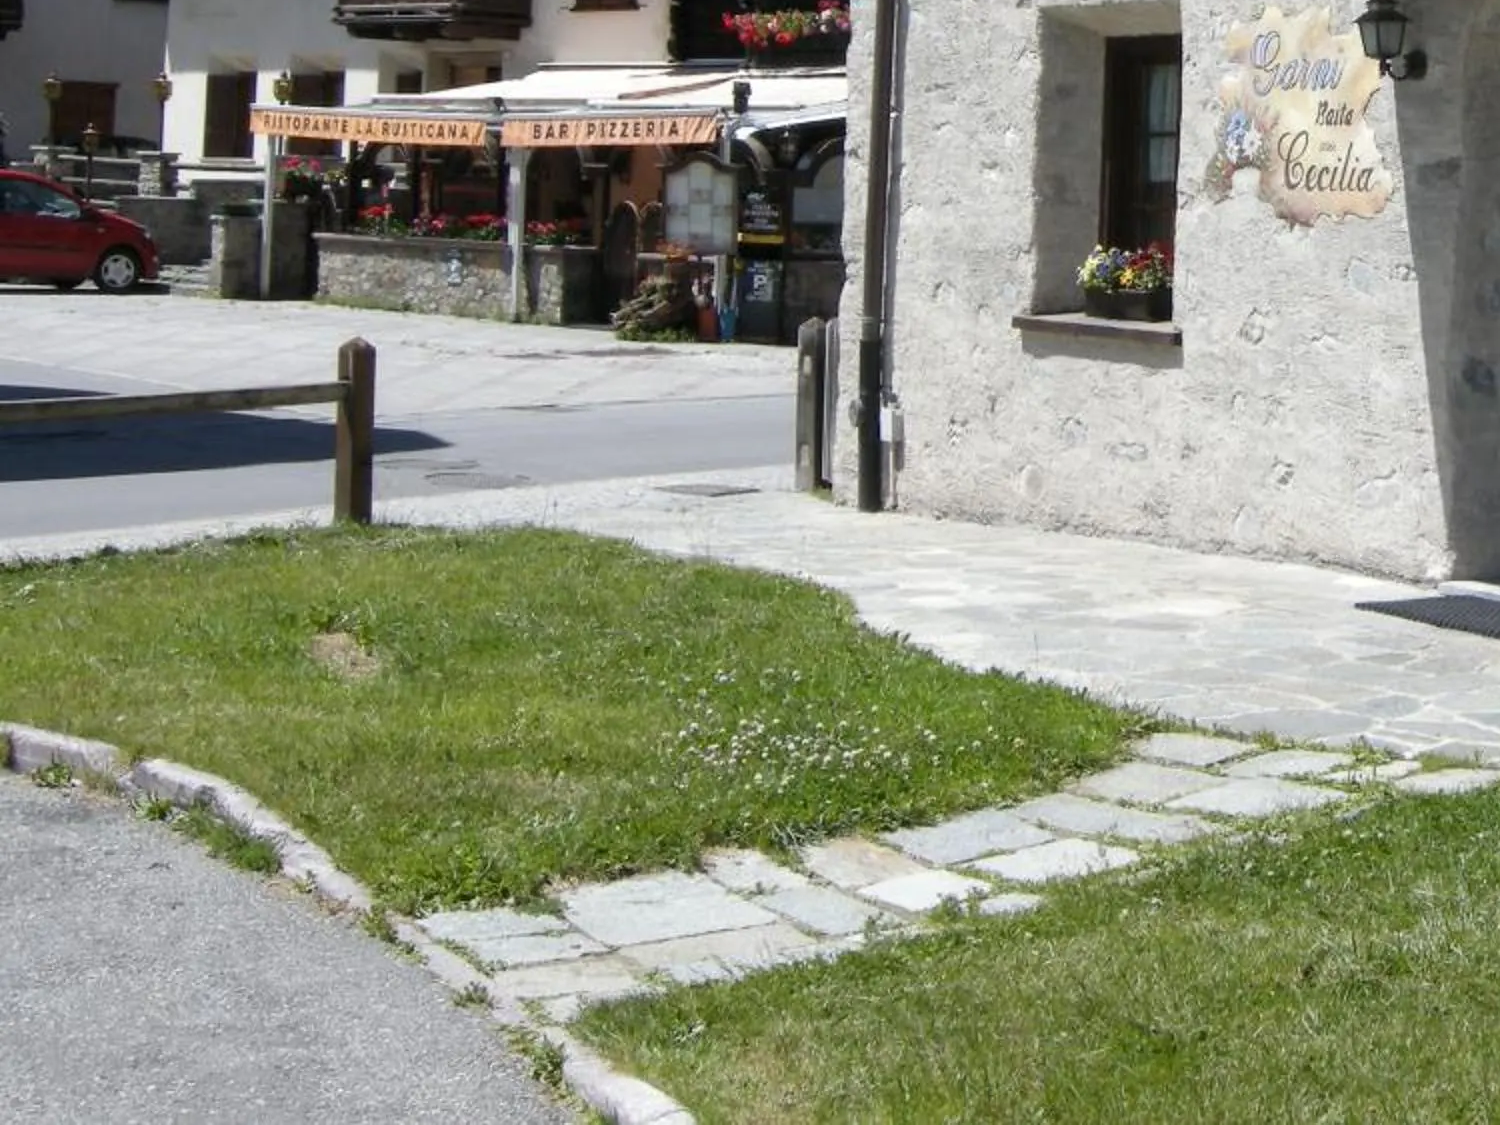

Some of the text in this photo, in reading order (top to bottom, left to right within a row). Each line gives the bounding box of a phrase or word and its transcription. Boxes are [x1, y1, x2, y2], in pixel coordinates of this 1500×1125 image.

[263, 112, 469, 139] RISTORANTE LA RUSTICANA
[532, 120, 680, 140] BAR PIZZERIA
[1277, 130, 1376, 193] Cecilia
